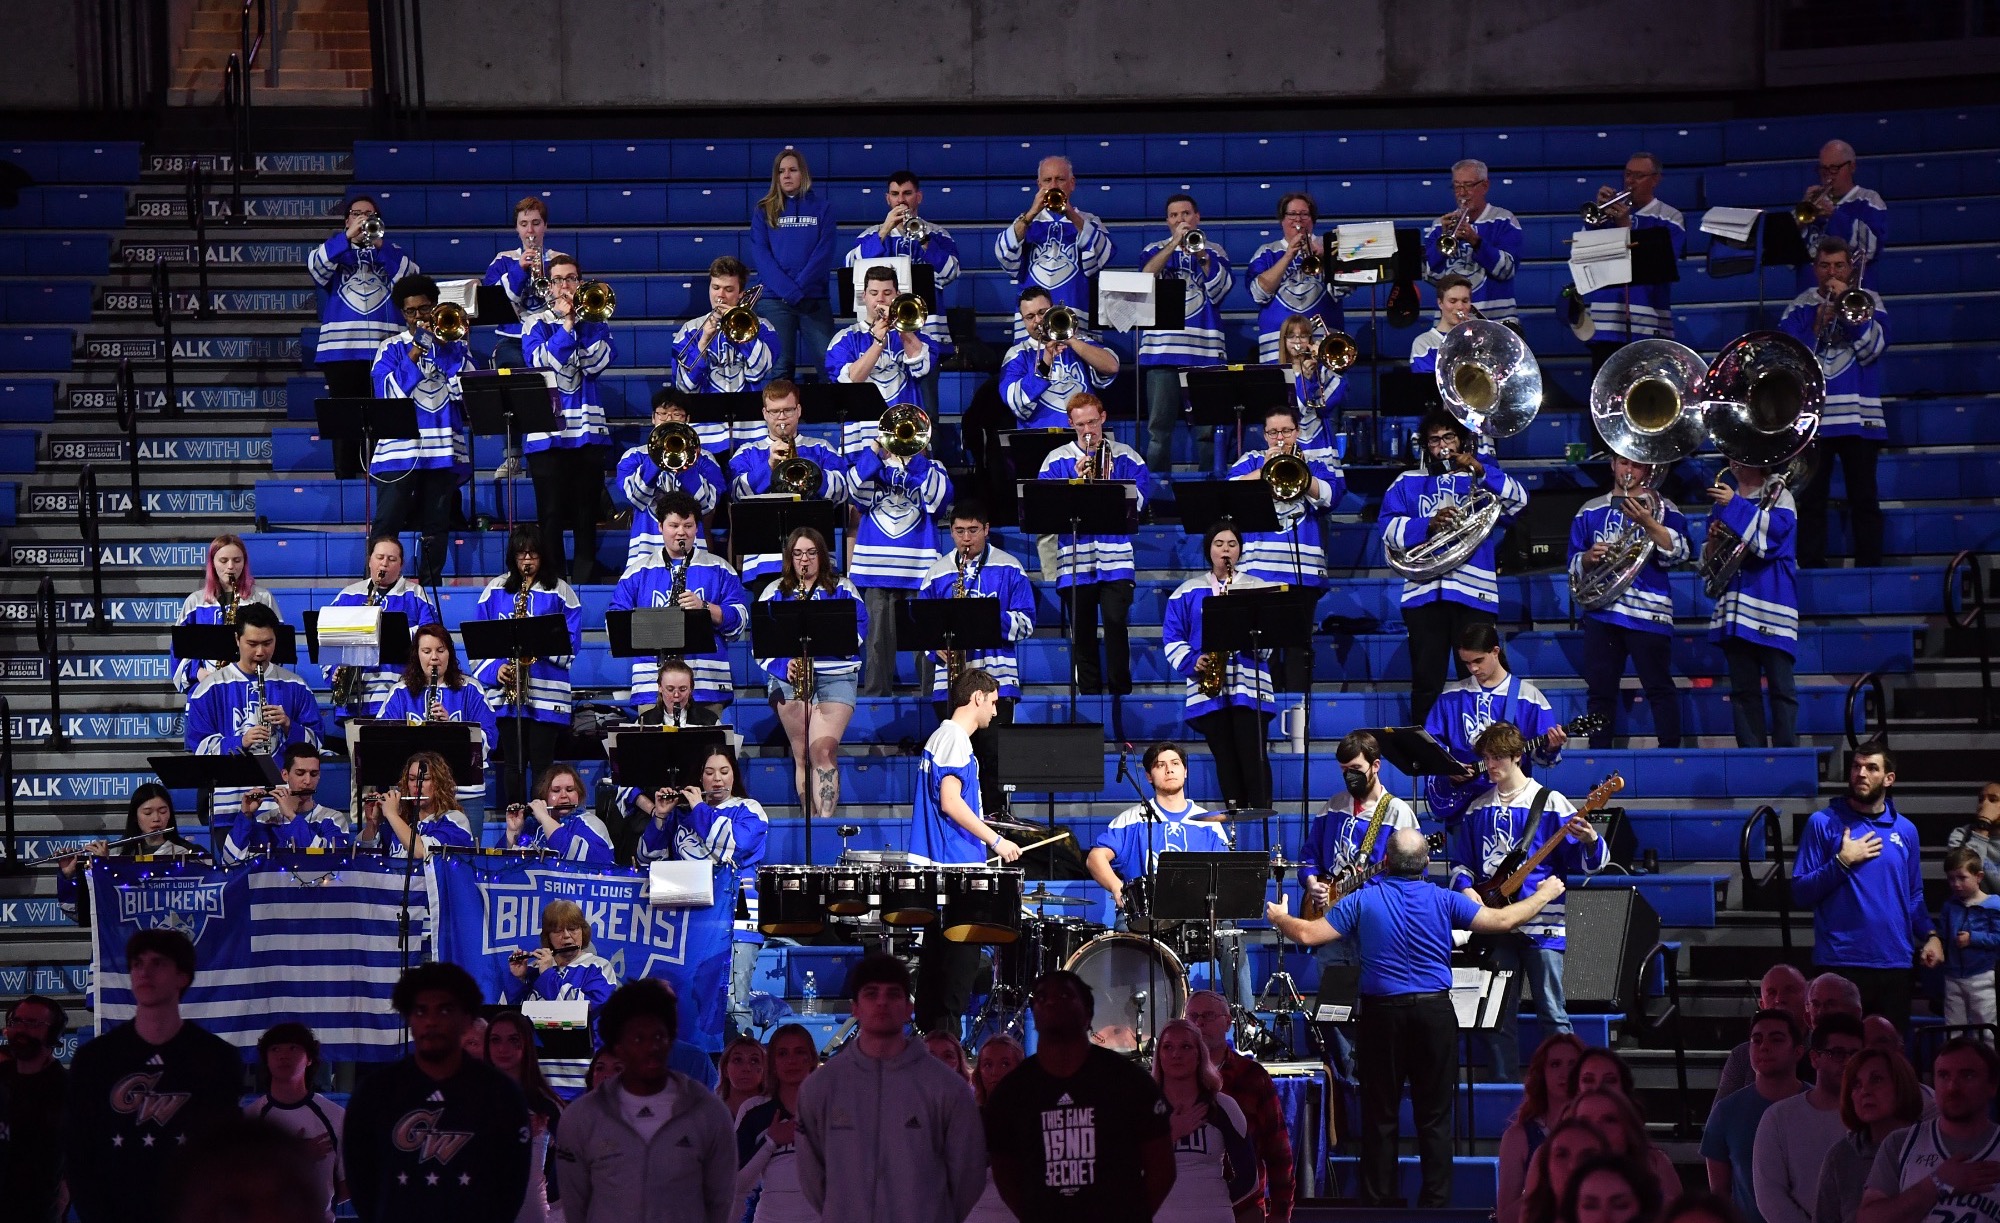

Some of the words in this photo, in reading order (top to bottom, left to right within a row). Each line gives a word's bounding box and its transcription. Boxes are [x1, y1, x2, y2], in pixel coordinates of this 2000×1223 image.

[153, 158, 183, 171] 988
[273, 155, 325, 172] WITH
[140, 203, 171, 216] 988
[208, 200, 257, 217] TAK
[262, 200, 315, 217] WITH
[125, 248, 156, 262] 988
[249, 246, 301, 262] WITH
[107, 295, 138, 309] 988
[177, 293, 227, 310] TAK
[232, 293, 286, 310] WITH
[90, 343, 121, 357] 988
[217, 340, 271, 357] WITH
[277, 340, 302, 357] US
[72, 392, 104, 407] 988
[144, 390, 196, 407] TAK
[201, 390, 256, 407] WITH
[263, 390, 288, 407] US
[53, 443, 86, 458] 988
[126, 441, 178, 458] ALK
[184, 440, 240, 458] WITH
[246, 440, 273, 458] US
[34, 495, 67, 510] 988
[108, 493, 162, 511] TAK
[167, 493, 224, 511] WITH
[230, 493, 257, 511] US
[14, 549, 48, 564] 988
[149, 546, 206, 564] WITH
[110, 659, 169, 677] WITH
[90, 717, 150, 737] WITH
[157, 716, 185, 735] US
[68, 777, 129, 796] WITH
[173, 881, 195, 889] LOUIS
[544, 880, 585, 896] SAINT
[590, 884, 633, 899] LOUIS
[125, 889, 218, 915] BILLIKENS
[495, 895, 678, 950] BILKENS
[1, 970, 65, 991] WITH
[1498, 970, 1513, 978] SLU
[1041, 1110, 1064, 1131] THIS
[1066, 1107, 1095, 1128] GAME
[1176, 1127, 1205, 1151] LU
[1045, 1159, 1096, 1187] SECRET
[1956, 1193, 2000, 1222] LOUI
